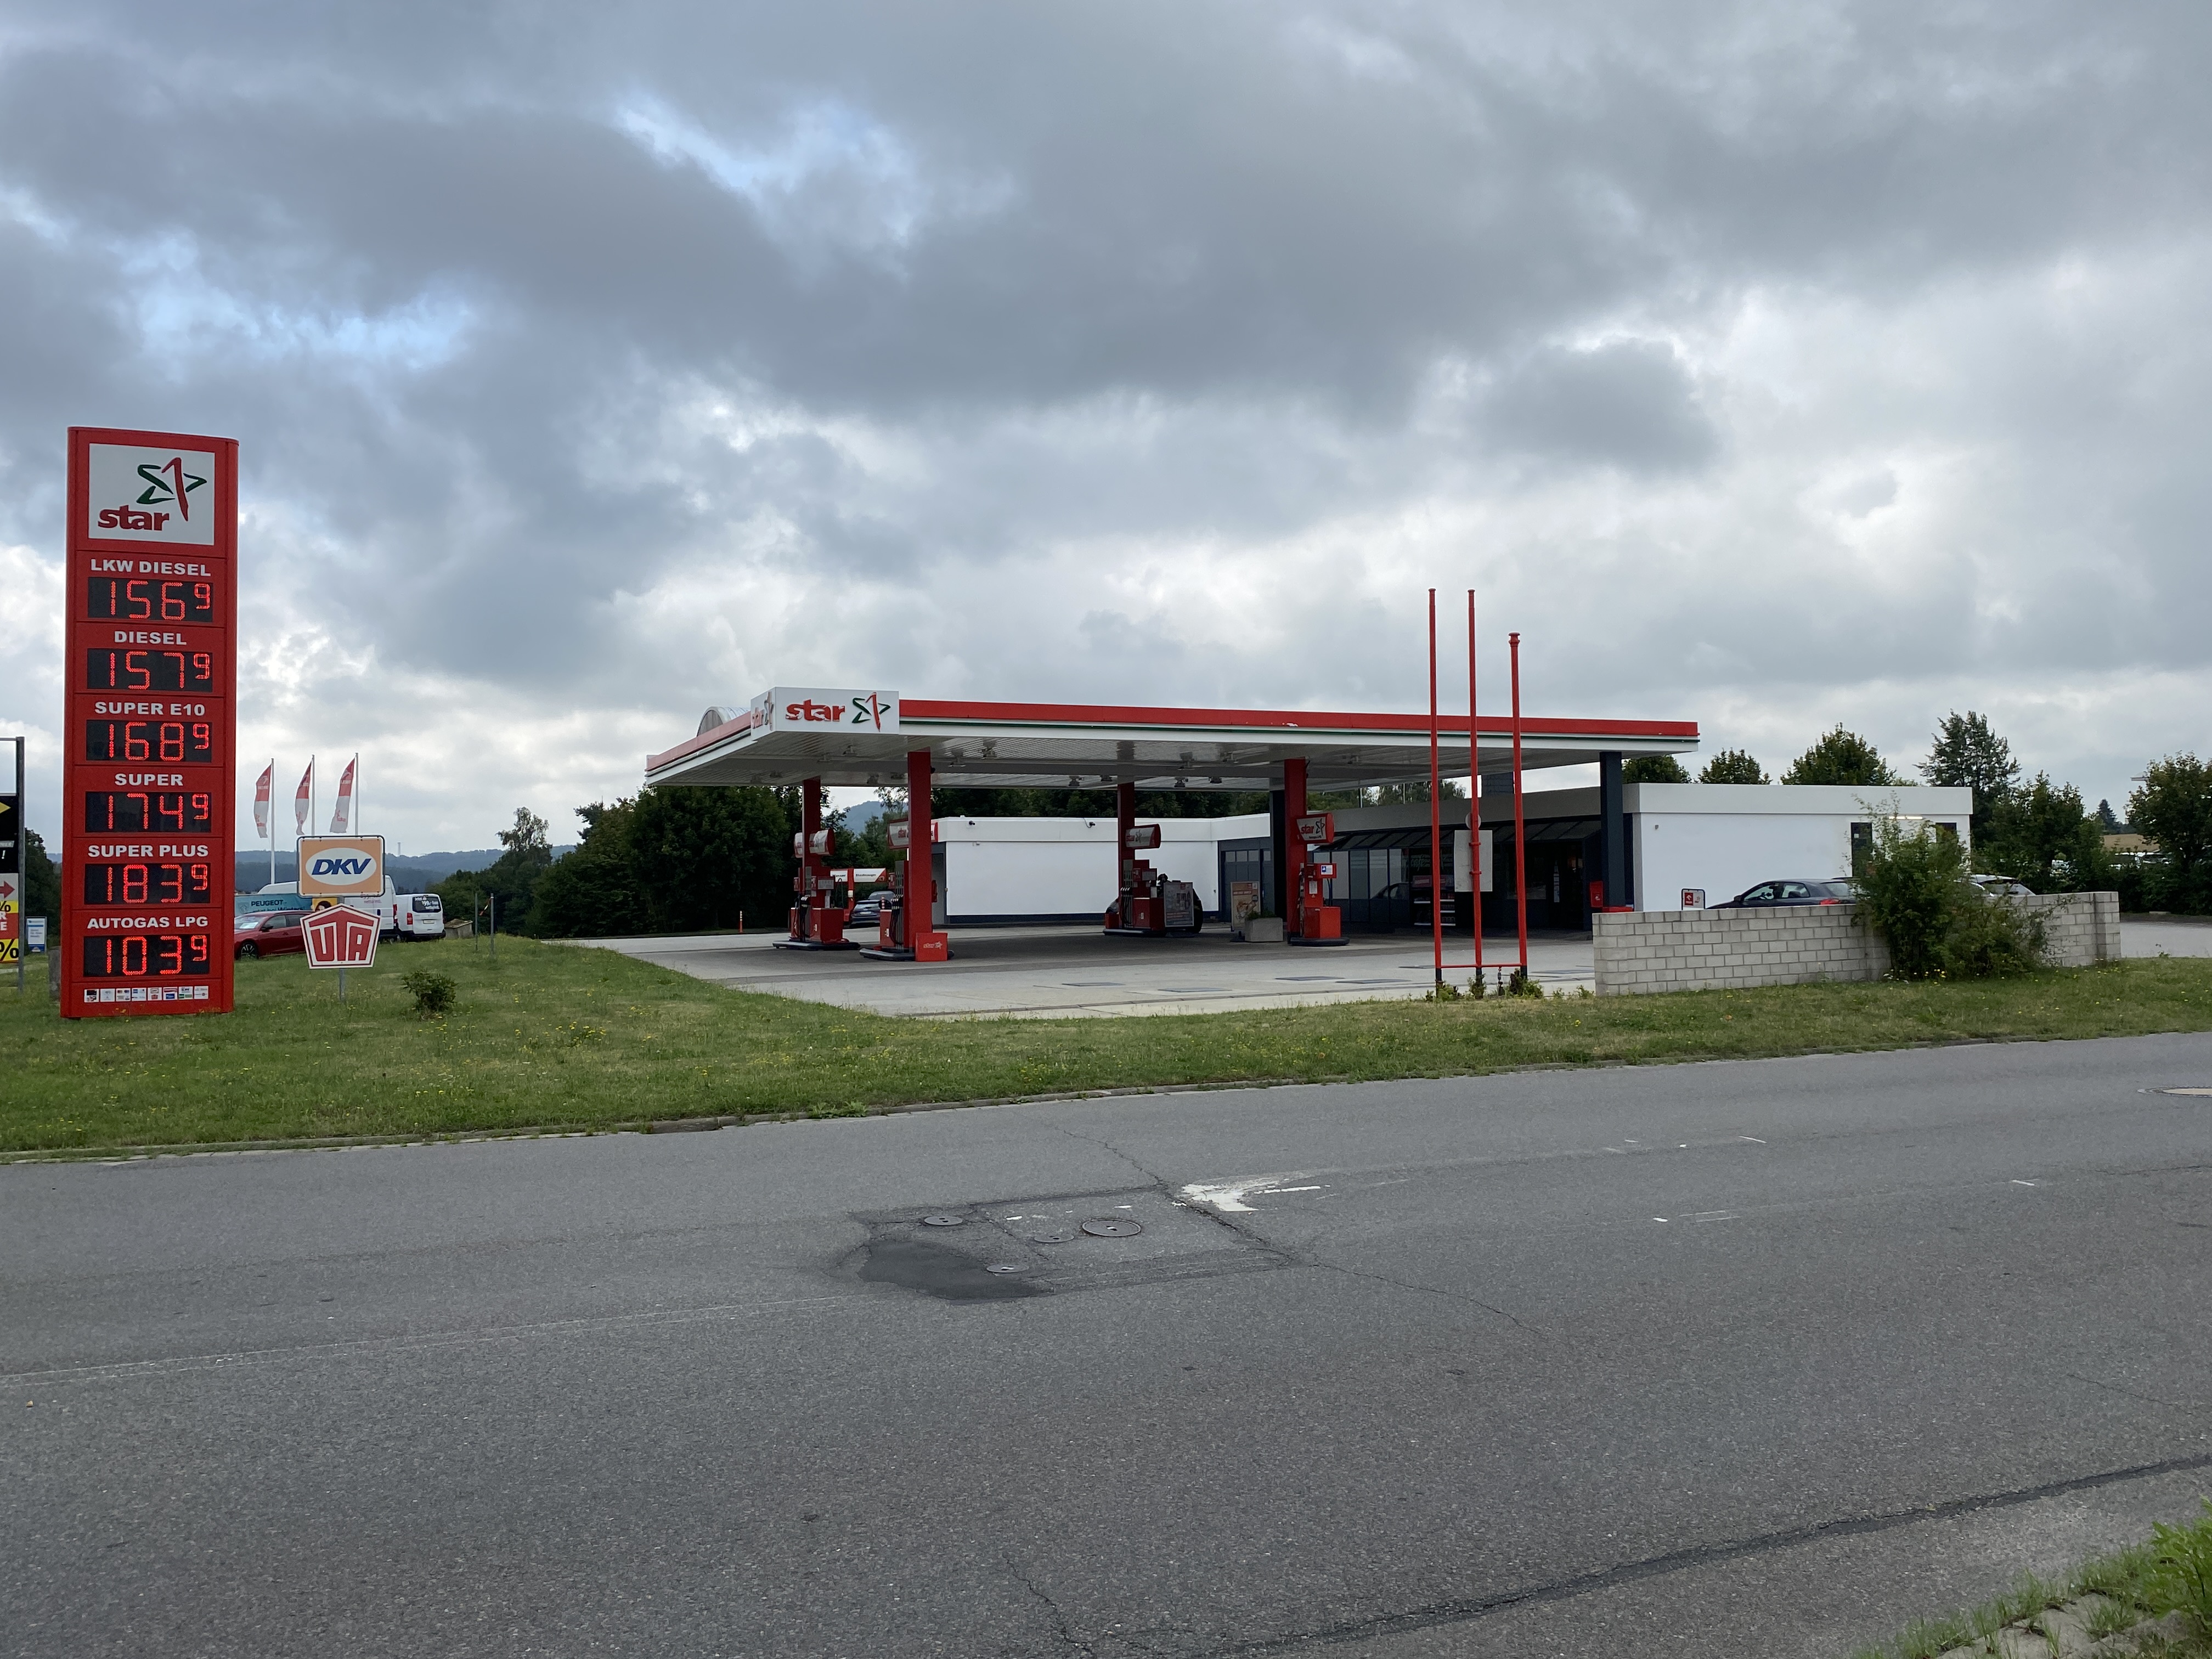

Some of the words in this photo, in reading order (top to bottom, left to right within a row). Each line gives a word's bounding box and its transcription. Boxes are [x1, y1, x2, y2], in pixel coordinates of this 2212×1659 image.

[98, 505, 170, 531] star
[91, 558, 133, 573] LKW
[139, 561, 211, 577] DIESEL
[114, 630, 187, 645] DIESEL
[95, 702, 163, 715] SUPER
[170, 703, 205, 716] E10
[785, 698, 845, 722] star
[115, 774, 183, 786] SUPER
[1301, 825, 1314, 834] star
[88, 845, 154, 857] SUPER
[159, 845, 208, 857] PLUS
[311, 858, 371, 876] DKV
[87, 917, 170, 929] AUTOGAS
[176, 916, 208, 927] LPG
[308, 907, 374, 962] UTA
